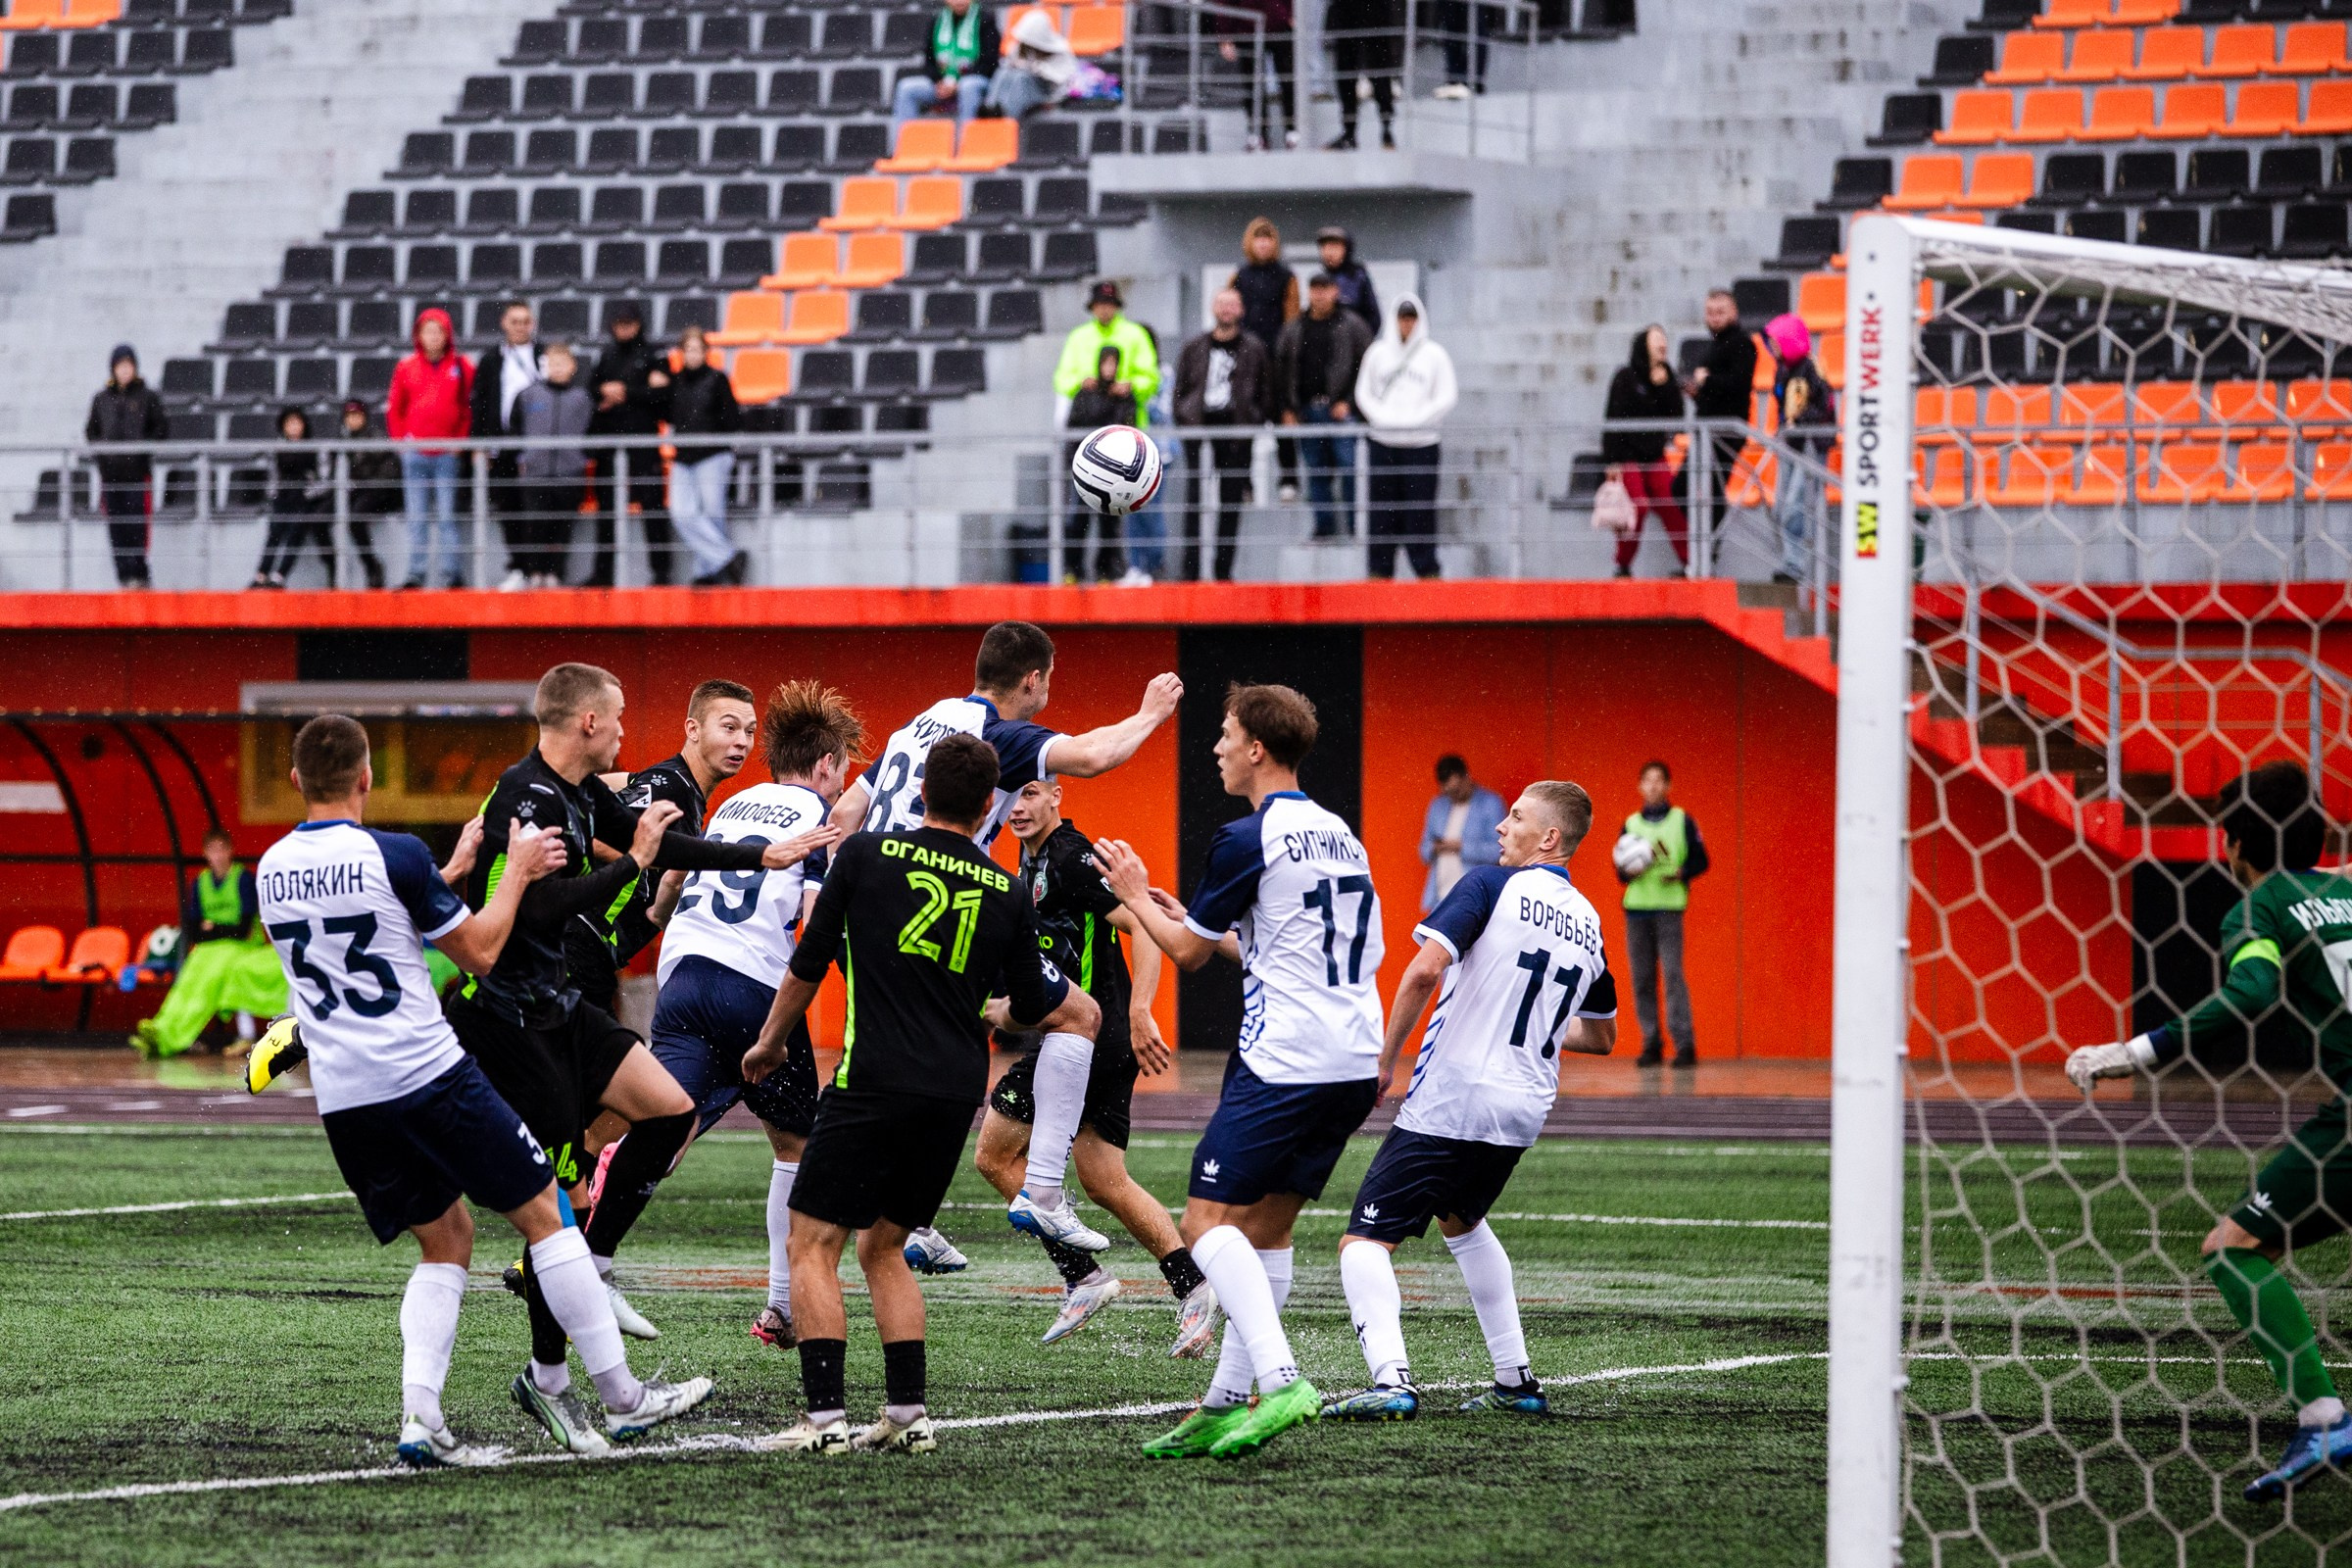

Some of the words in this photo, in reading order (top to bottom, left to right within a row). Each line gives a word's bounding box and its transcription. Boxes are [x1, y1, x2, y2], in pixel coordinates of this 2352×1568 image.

[1856, 307, 1883, 487] SPORTWERK
[715, 800, 802, 829] ИМОФЕЕВ
[1284, 830, 1365, 862] СИТНИКО
[261, 862, 364, 906] ПОЛЯКИН
[881, 839, 1010, 893] ОГАНИЧЕВ
[898, 870, 984, 974] 21
[1302, 874, 1374, 987] 17
[1519, 896, 1597, 956] ВОРОБЬЁВ
[268, 911, 403, 1022] 33
[1509, 947, 1584, 1060] 11
